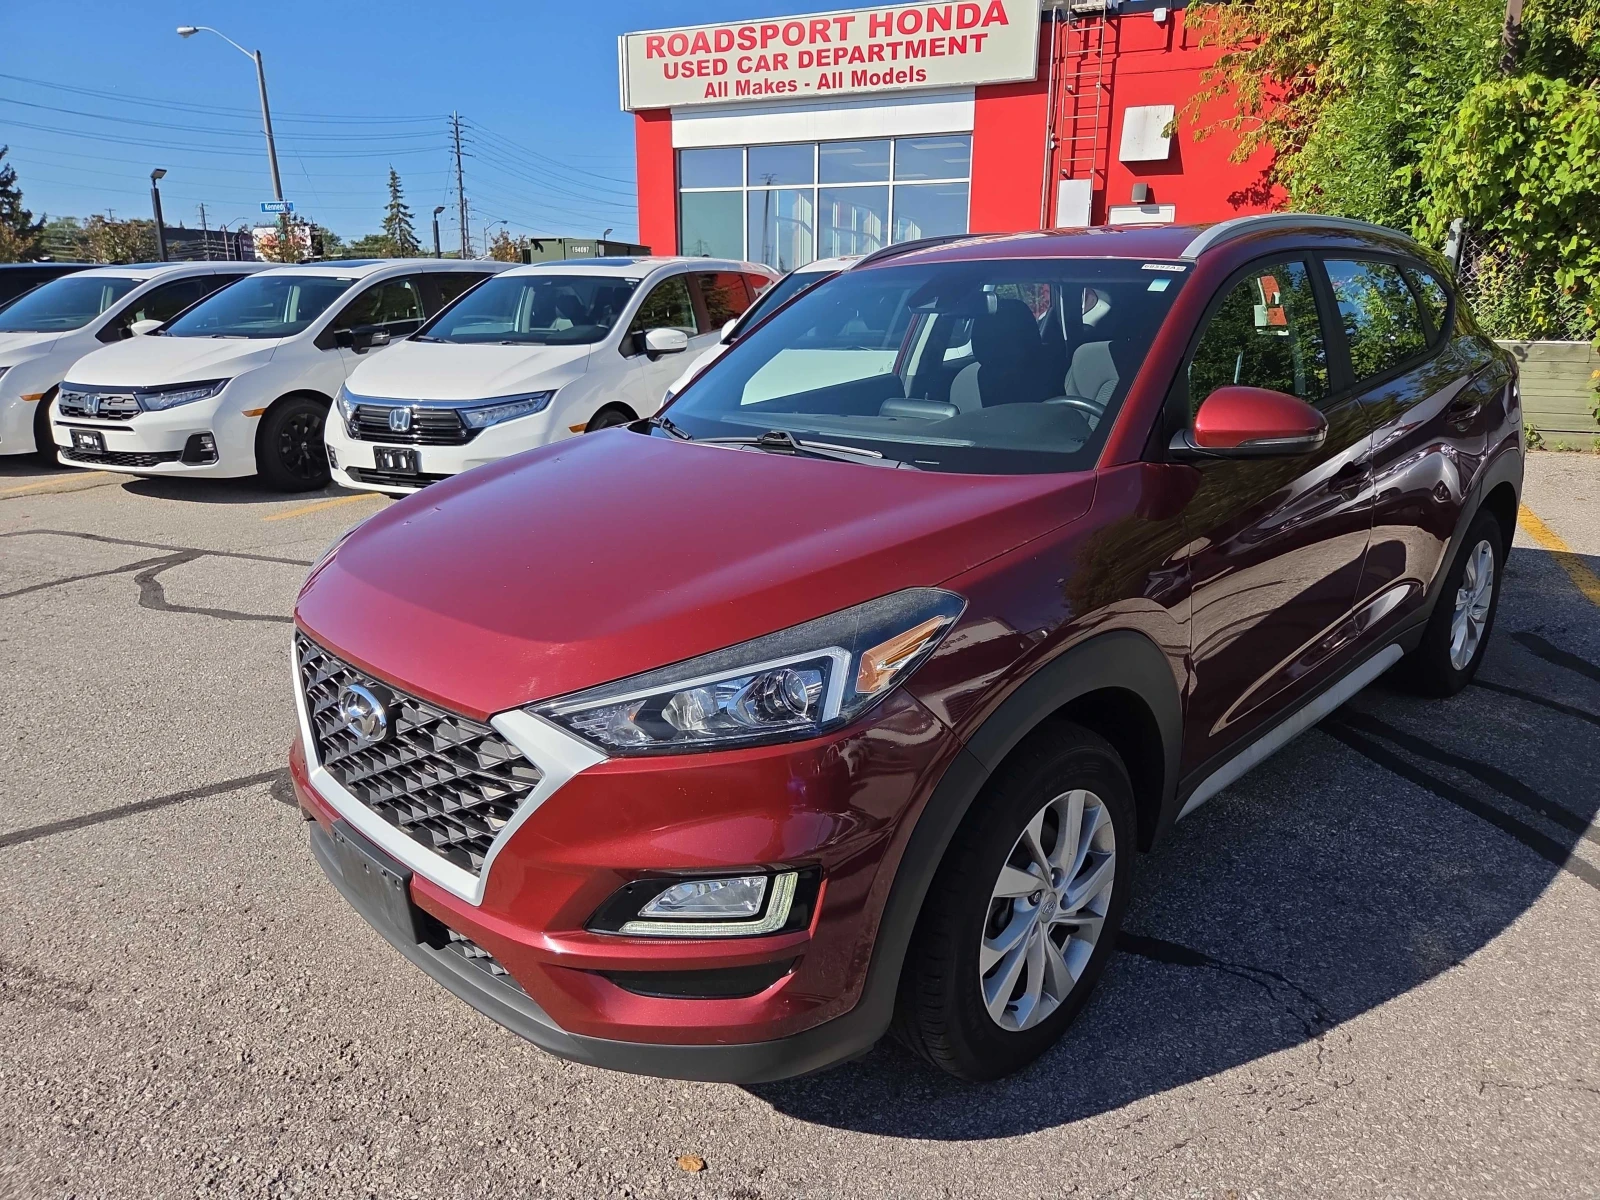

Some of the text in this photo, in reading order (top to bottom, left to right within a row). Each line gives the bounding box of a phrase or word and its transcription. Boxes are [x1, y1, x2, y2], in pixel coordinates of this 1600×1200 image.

[646, 0, 1010, 59] ROADSPORT HONDA
[663, 33, 989, 80] USED CAR DEPARTMENT
[704, 81, 728, 98] All
[735, 78, 798, 97] Makes
[816, 71, 843, 90] All
[851, 65, 927, 88] Models
